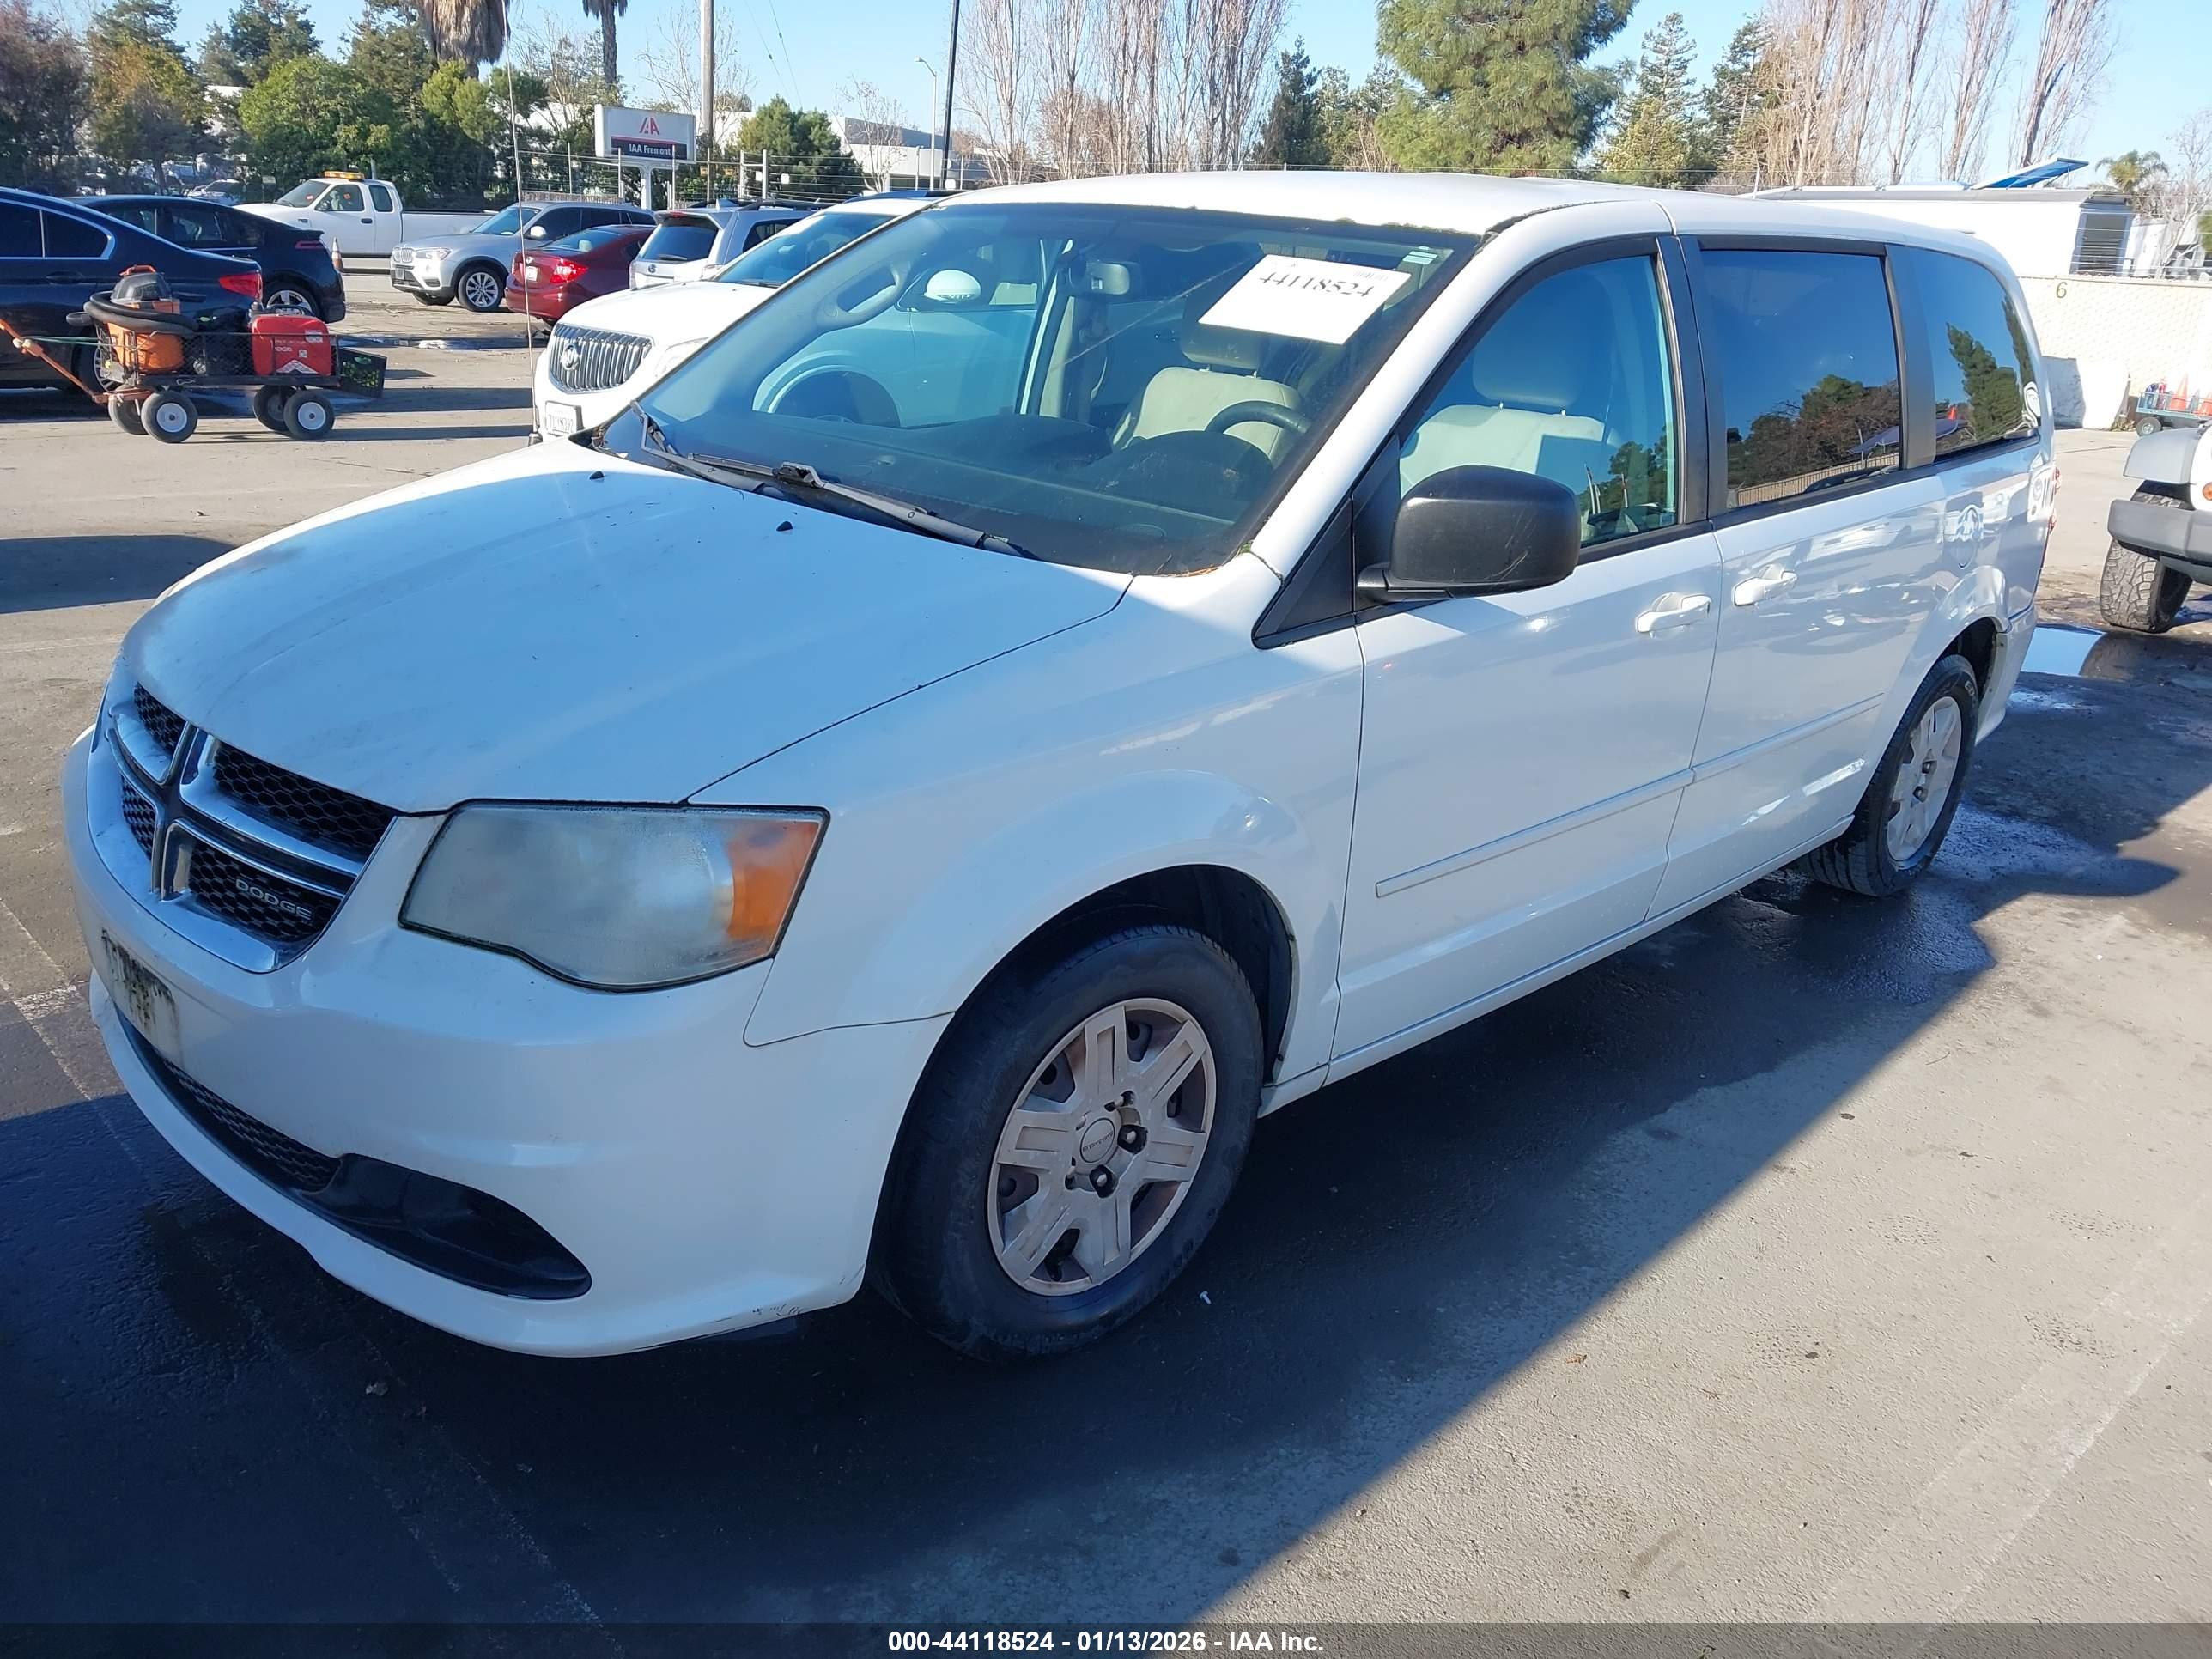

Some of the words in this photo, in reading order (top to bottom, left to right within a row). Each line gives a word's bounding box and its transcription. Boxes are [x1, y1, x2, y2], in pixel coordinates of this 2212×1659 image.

[629, 143, 642, 153] IAA
[644, 144, 671, 155] Fremont
[1260, 272, 1374, 297] 44118524
[2056, 281, 2068, 298] 6
[235, 878, 312, 921] DODGE
